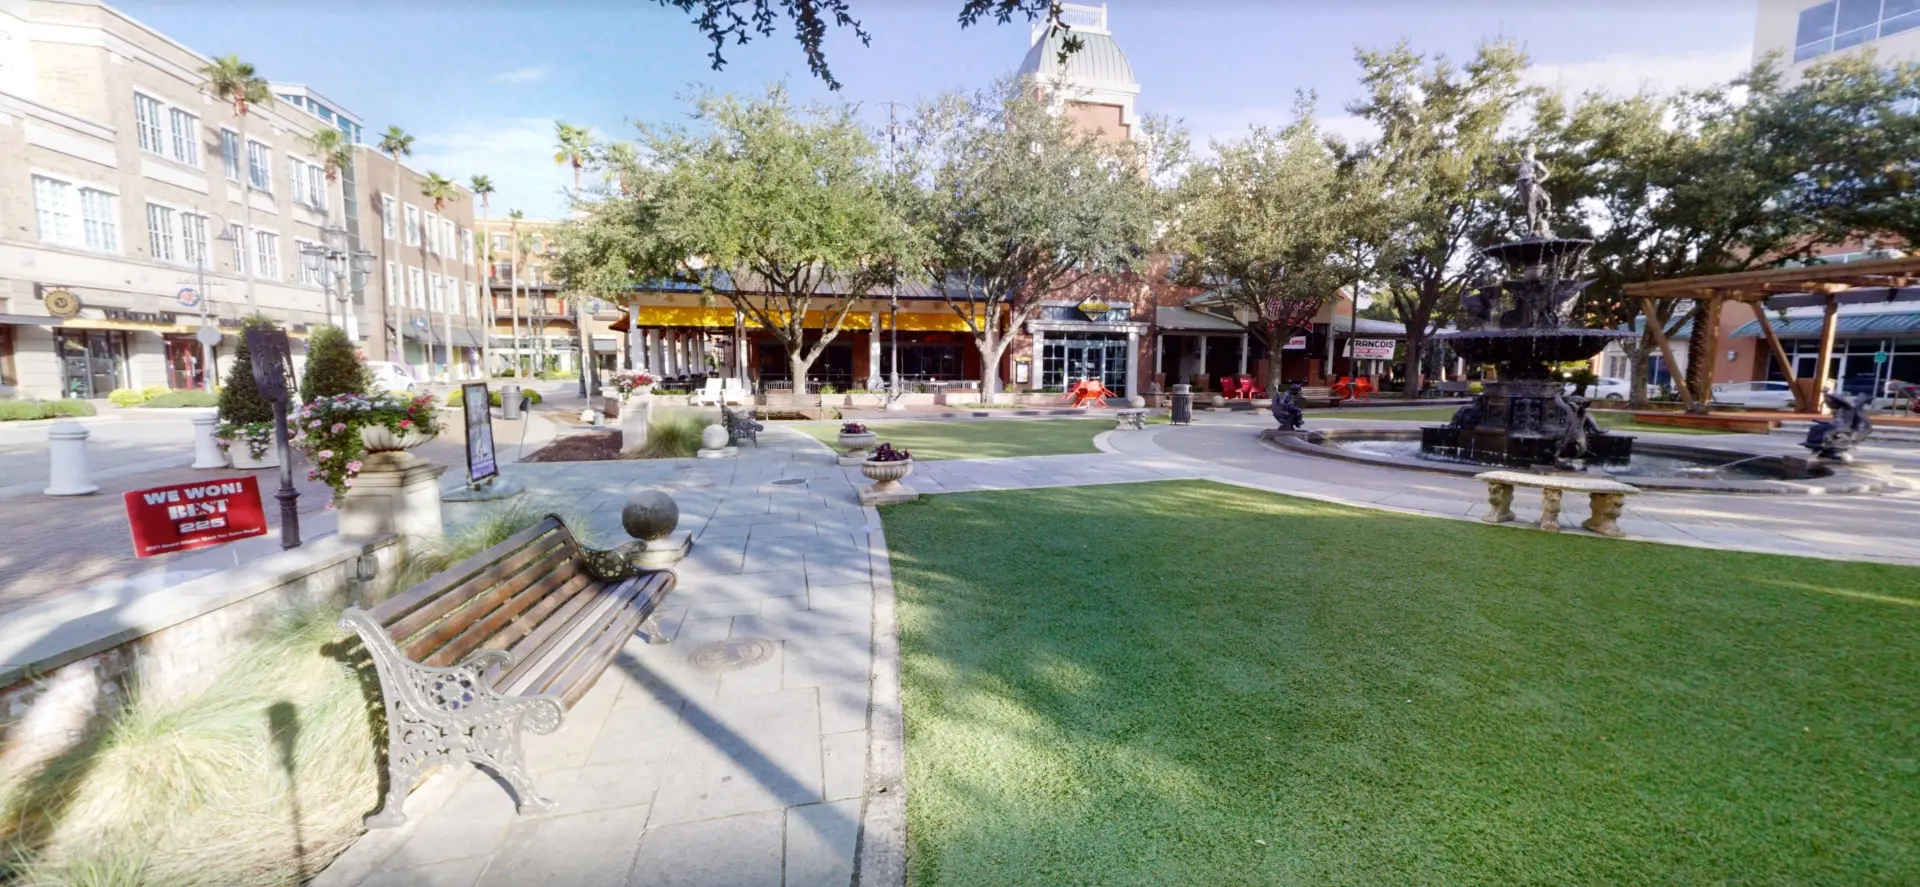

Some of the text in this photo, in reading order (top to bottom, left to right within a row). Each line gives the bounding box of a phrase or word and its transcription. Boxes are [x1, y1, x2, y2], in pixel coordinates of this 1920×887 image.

[143, 482, 243, 506] WE WON!
[168, 499, 229, 520] BEST
[180, 517, 226, 533] 225
